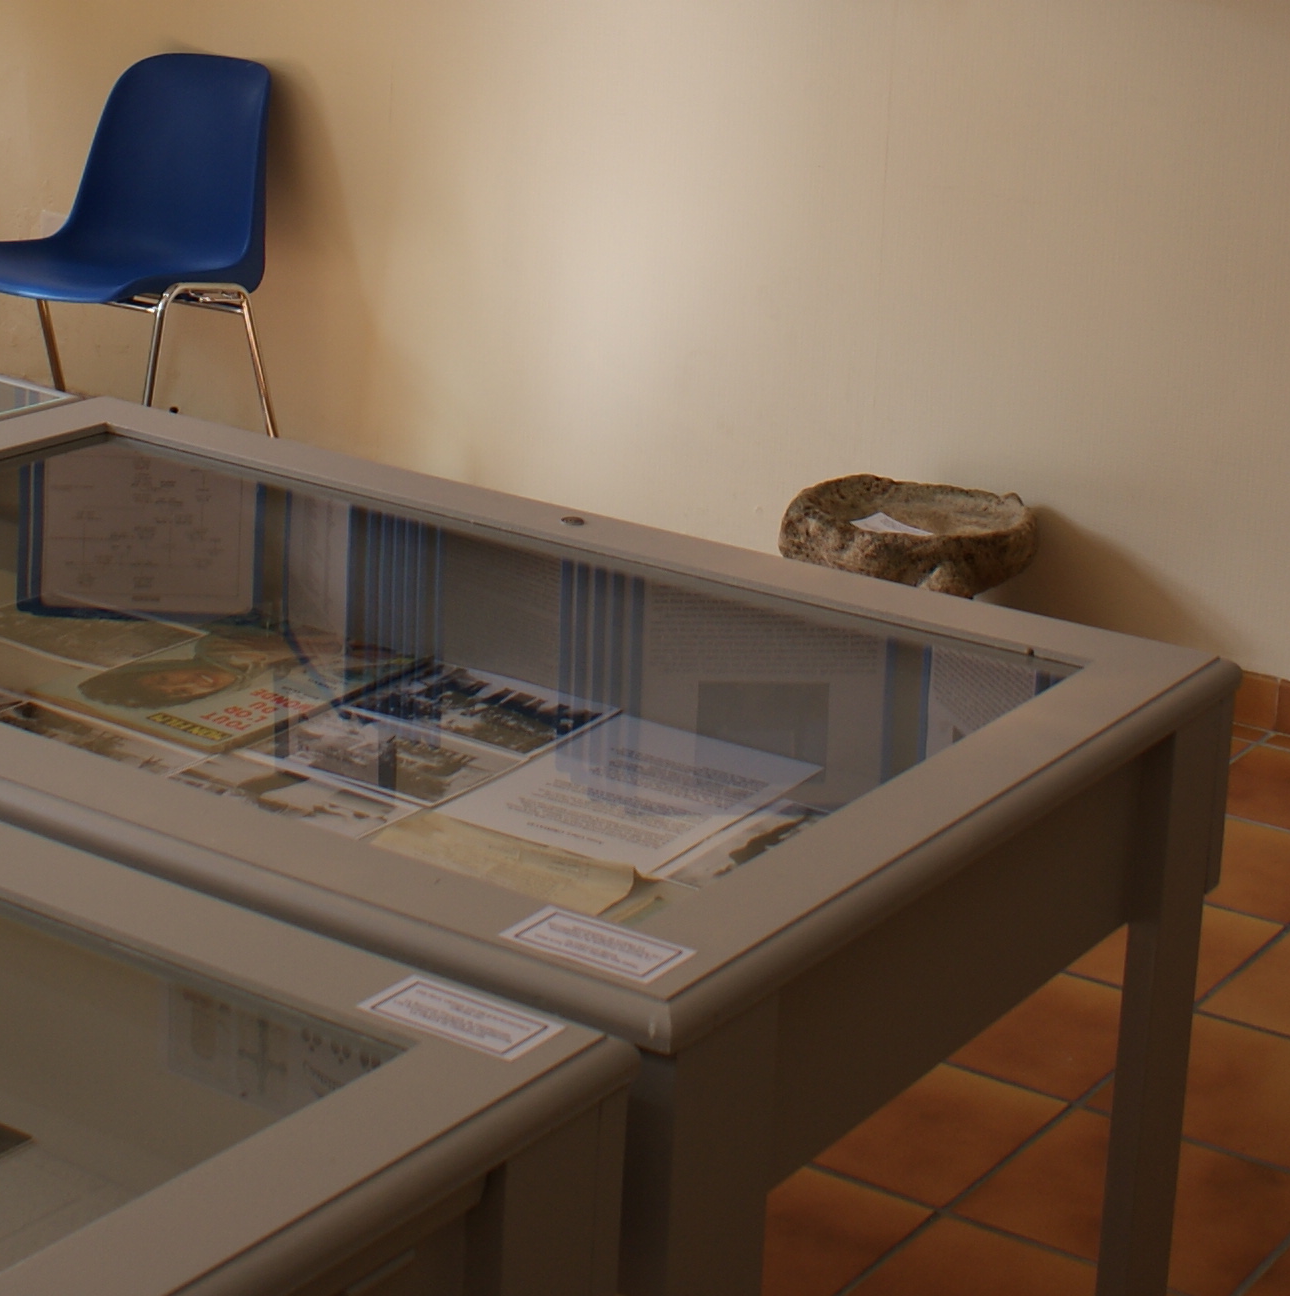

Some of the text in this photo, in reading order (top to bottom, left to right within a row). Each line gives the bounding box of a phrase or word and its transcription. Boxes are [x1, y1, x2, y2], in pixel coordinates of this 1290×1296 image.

[224, 705, 268, 723] L'OR
[249, 701, 278, 714] DU
[200, 711, 251, 731] TOUT
